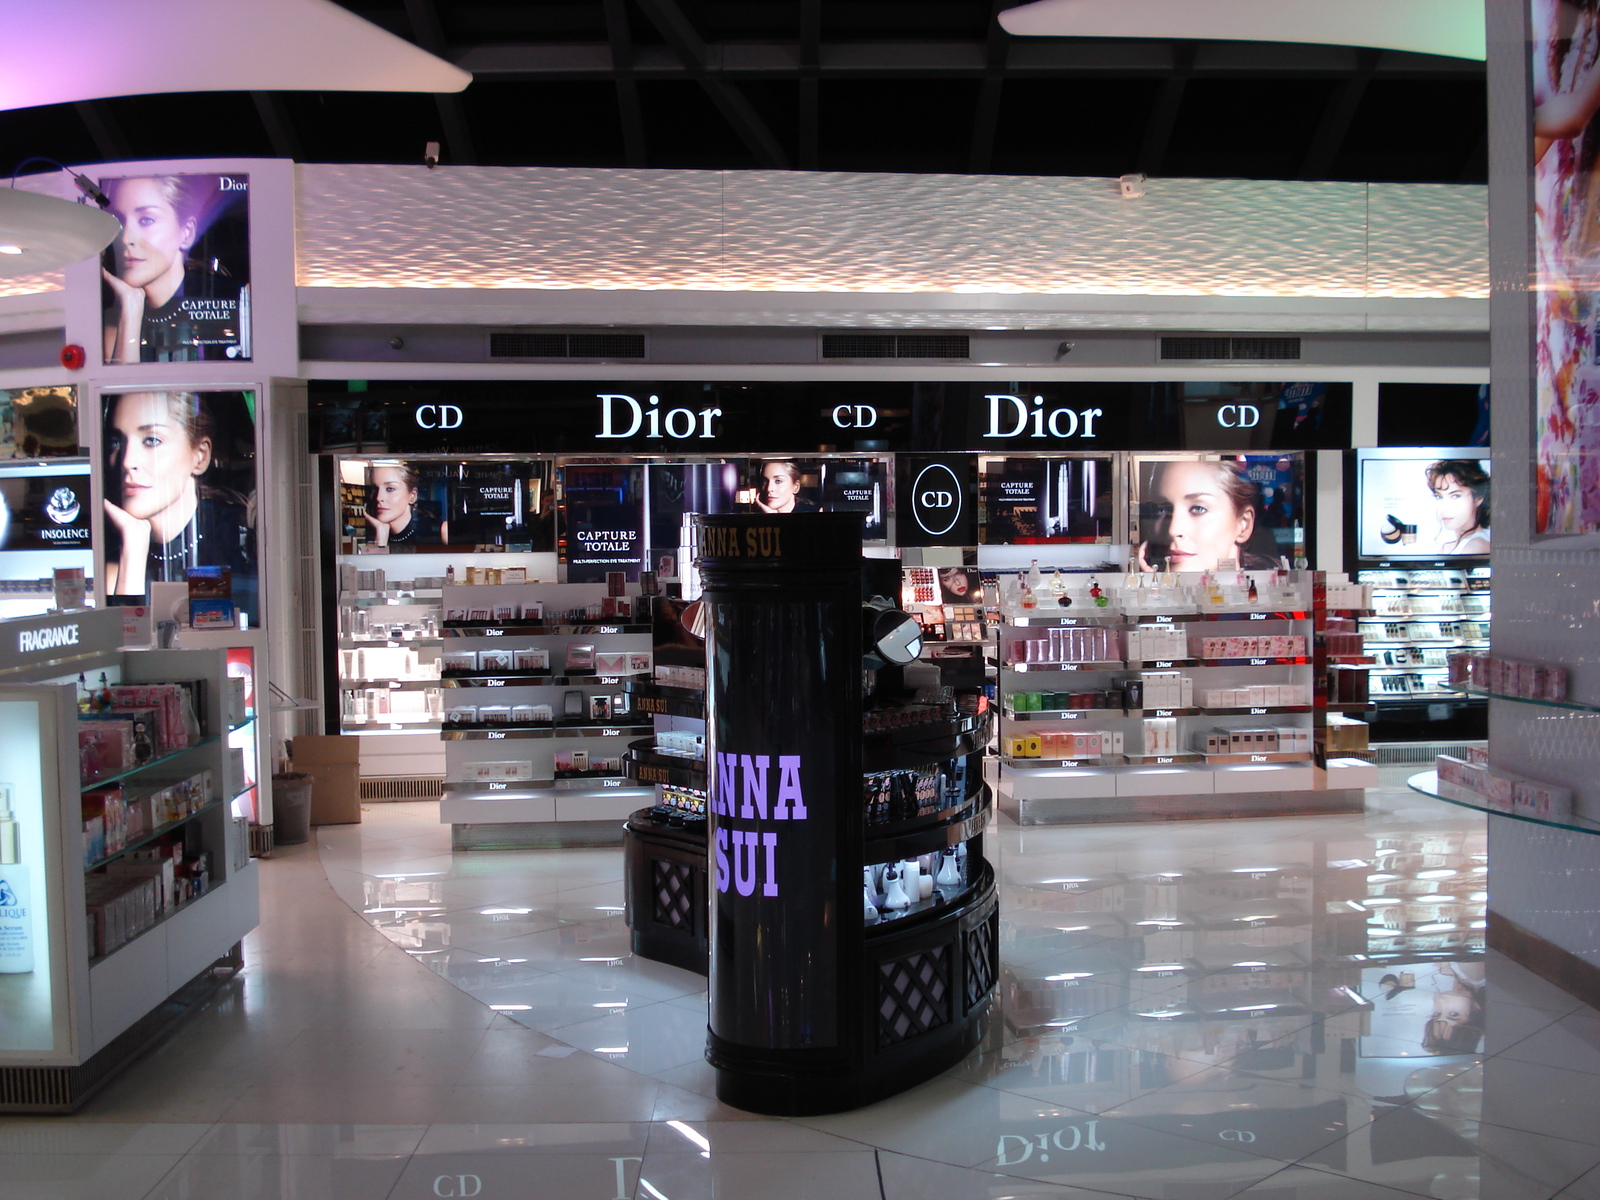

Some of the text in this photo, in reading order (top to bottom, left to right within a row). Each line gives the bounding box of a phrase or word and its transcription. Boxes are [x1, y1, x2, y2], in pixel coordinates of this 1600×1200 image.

[219, 176, 248, 191] Dior
[181, 300, 236, 310] CAPTURE
[188, 310, 230, 320] TOTALE
[415, 404, 463, 429] CD
[595, 394, 722, 439] Dior
[832, 404, 877, 428] CD
[982, 394, 1103, 438] Dior
[1217, 404, 1260, 428] CD
[921, 491, 952, 508] CD
[42, 528, 89, 540] INSOLENCE
[577, 530, 637, 541] CAPTURE
[701, 527, 781, 557] ANNA SUI
[584, 541, 630, 552] TOTALE
[19, 623, 79, 653] FRAGRANCE
[637, 697, 668, 713] ANNA SUI
[639, 766, 670, 783] ANNA SUI
[716, 827, 778, 897] SUI
